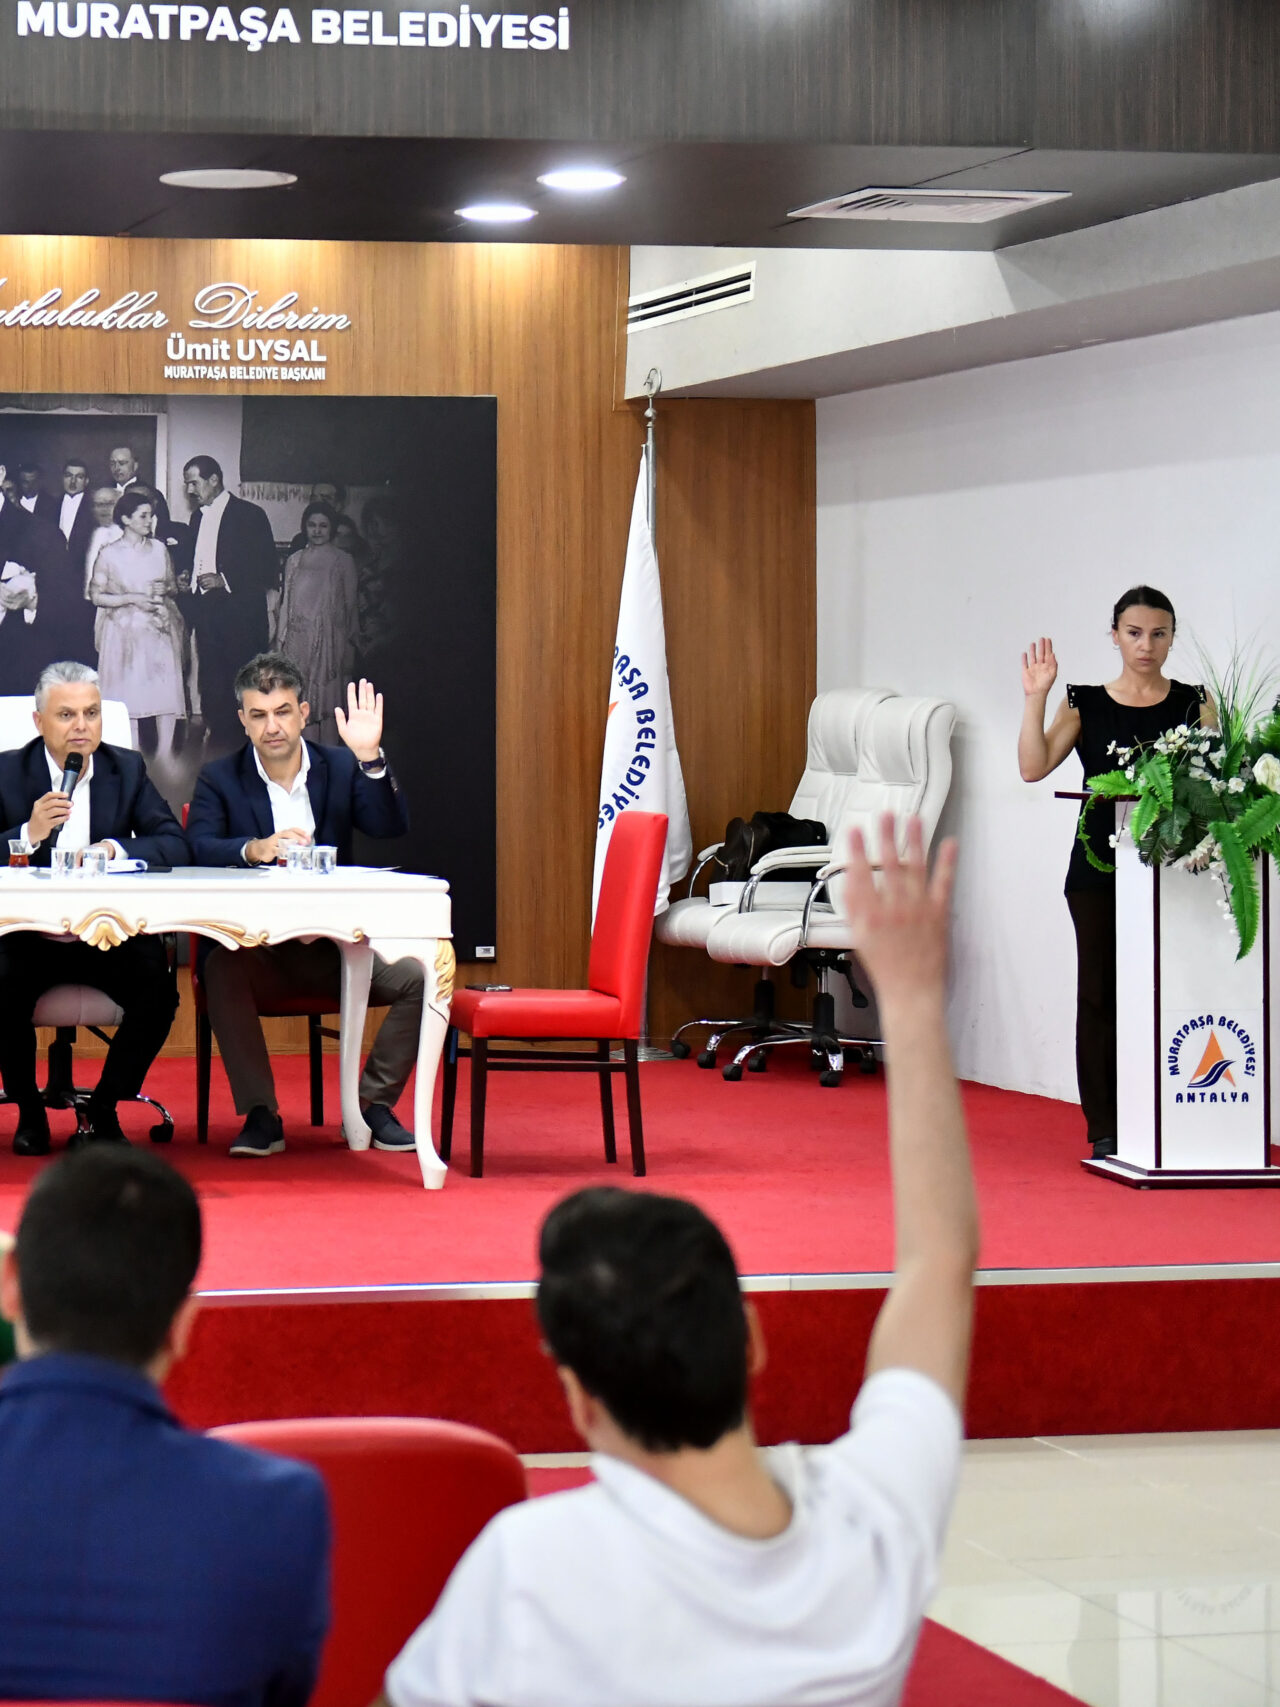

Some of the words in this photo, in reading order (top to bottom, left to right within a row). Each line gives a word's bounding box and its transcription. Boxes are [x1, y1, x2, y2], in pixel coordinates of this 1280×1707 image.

[17, 0, 301, 52] MURATPAŞA
[311, 4, 570, 51] BELEDİYESİ
[188, 281, 352, 331] Dilerim
[166, 332, 231, 361] Ümit
[236, 338, 327, 362] UYSAL
[164, 365, 228, 381] MURATPAŞA
[229, 366, 279, 380] BELEDİYE
[280, 367, 326, 381] BAŞKANI
[1167, 1014, 1214, 1076] MURATPAŞA
[1218, 1016, 1256, 1077] BELEDİYESİ
[1175, 1092, 1249, 1103] ANTALYA
